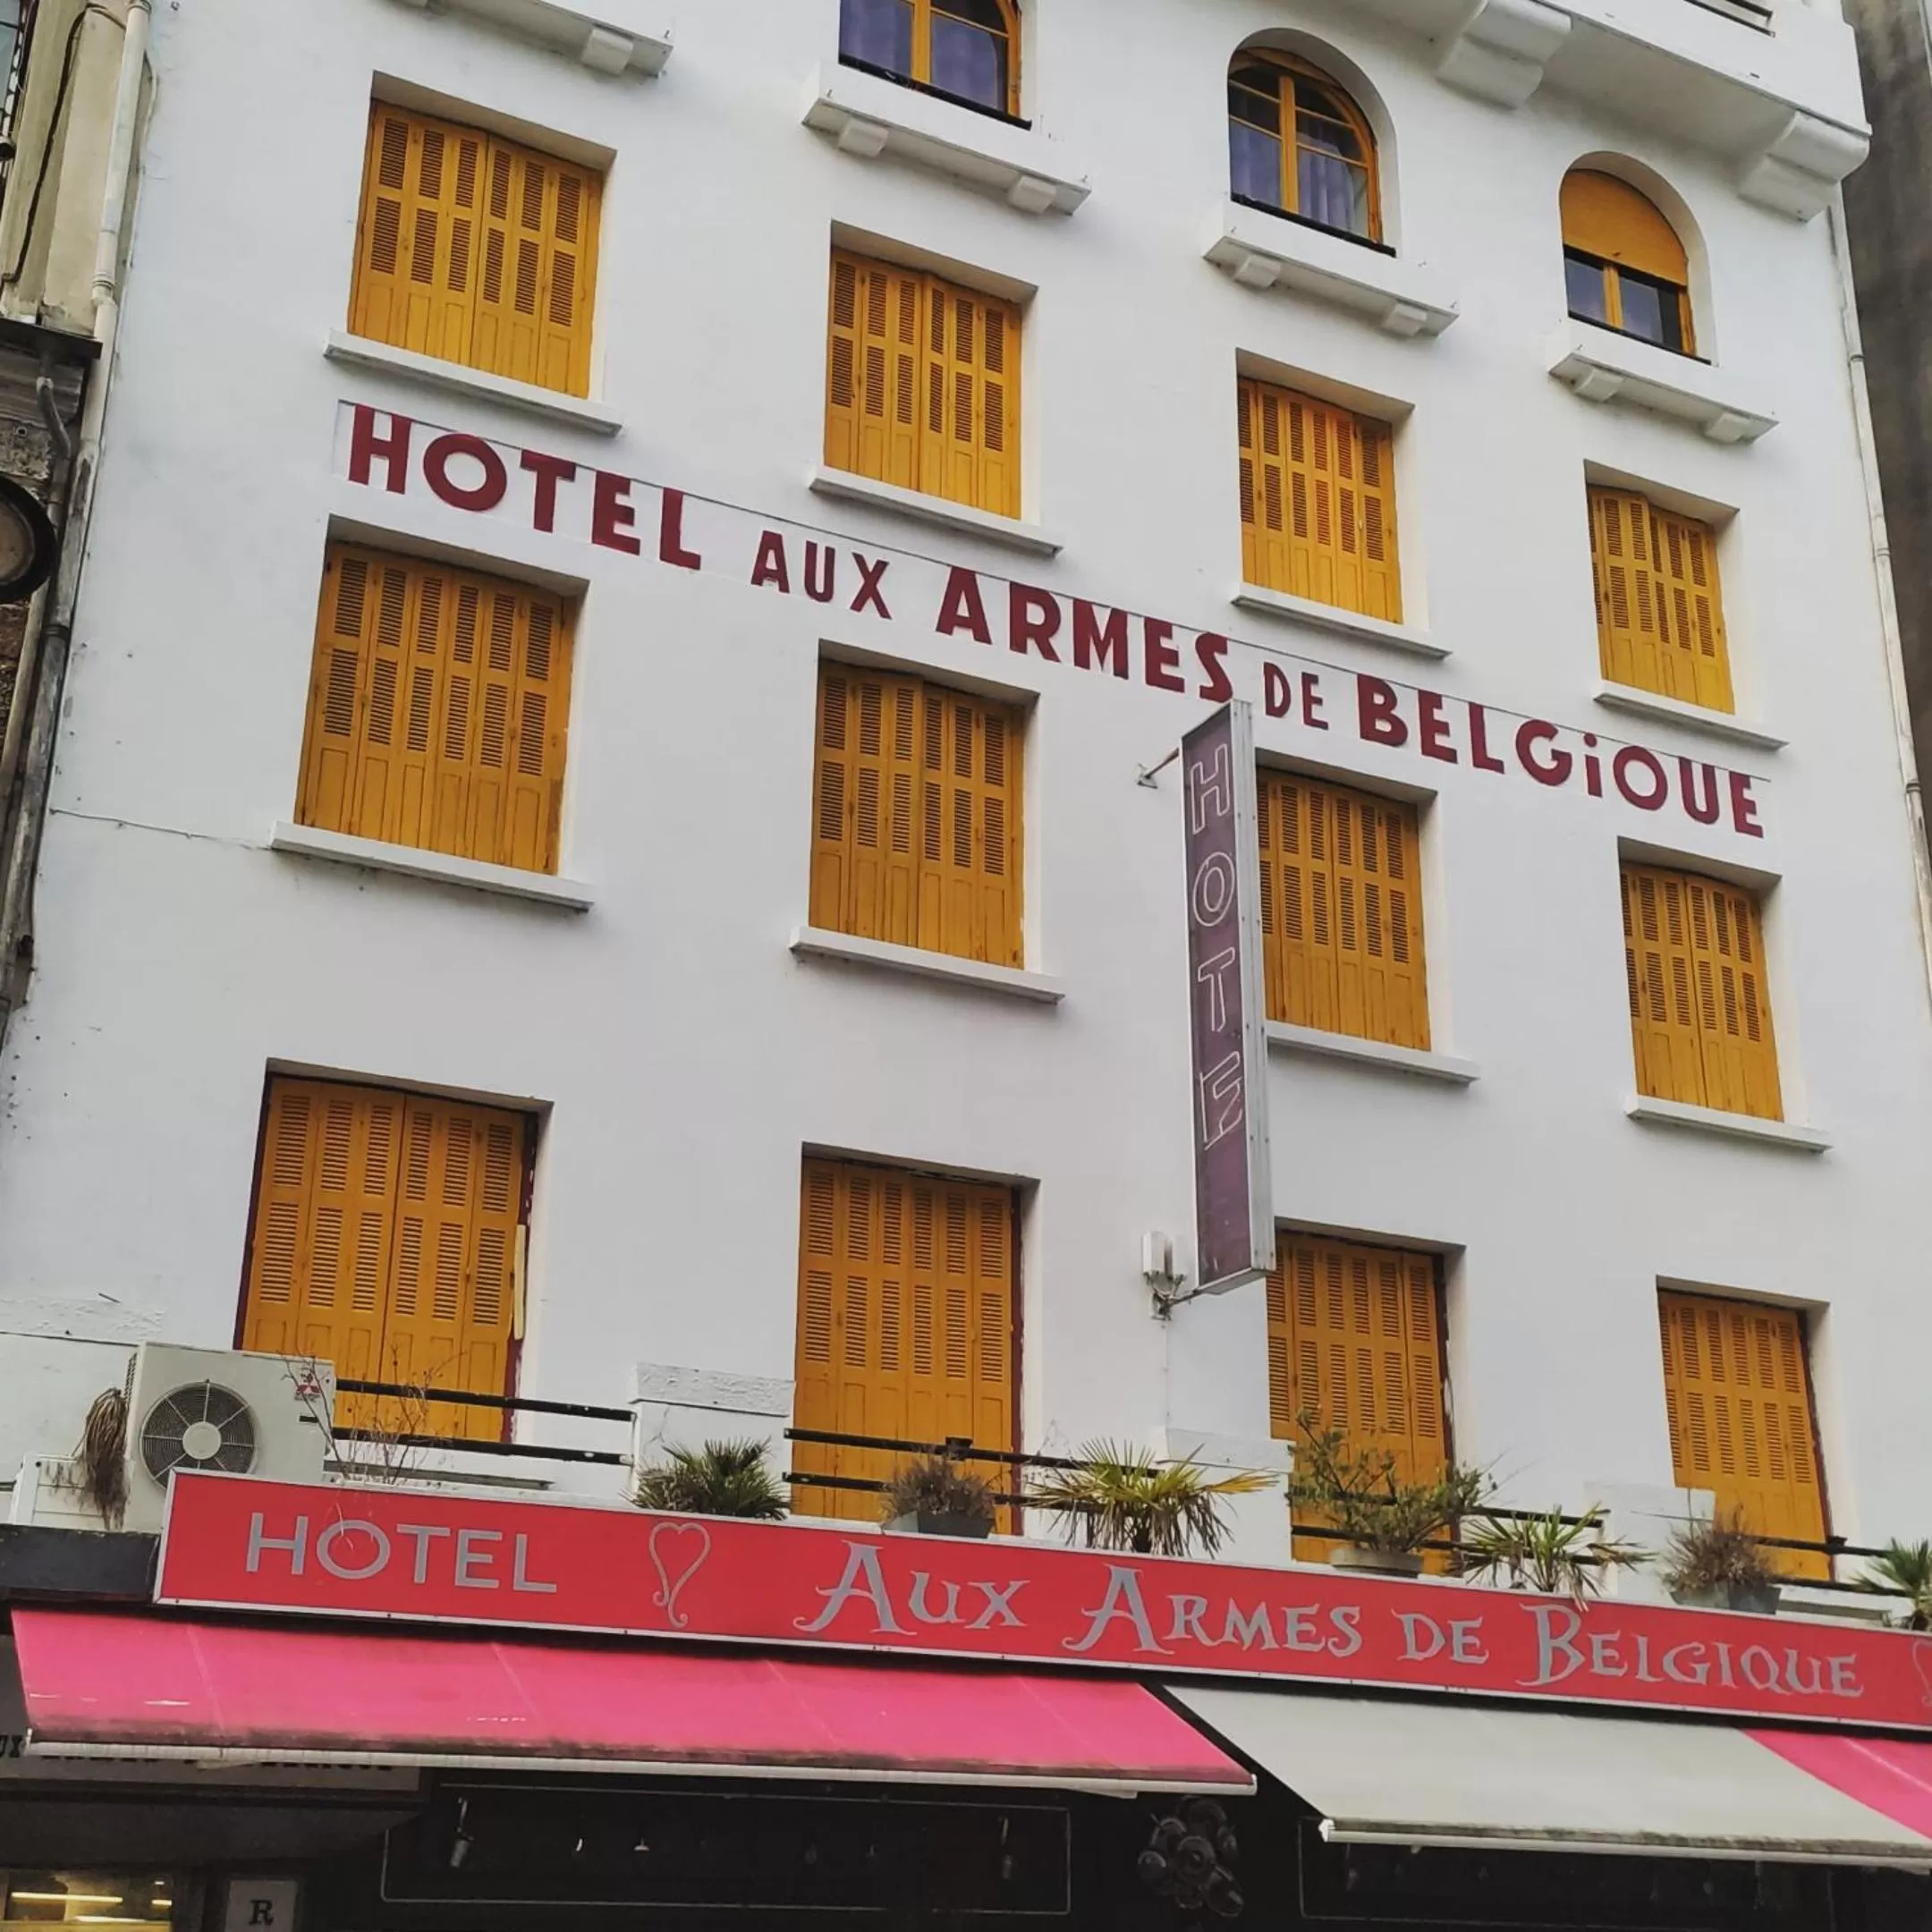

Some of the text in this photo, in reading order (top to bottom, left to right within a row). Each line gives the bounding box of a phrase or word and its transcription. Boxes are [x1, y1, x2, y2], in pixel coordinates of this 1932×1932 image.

[348, 402, 701, 571] HOTEL
[750, 530, 893, 620] AUX
[935, 565, 1233, 704] ARMES
[1263, 662, 1329, 730] DE
[246, 1512, 557, 1594] HOTEL
[1390, 1607, 1489, 1665] DE
